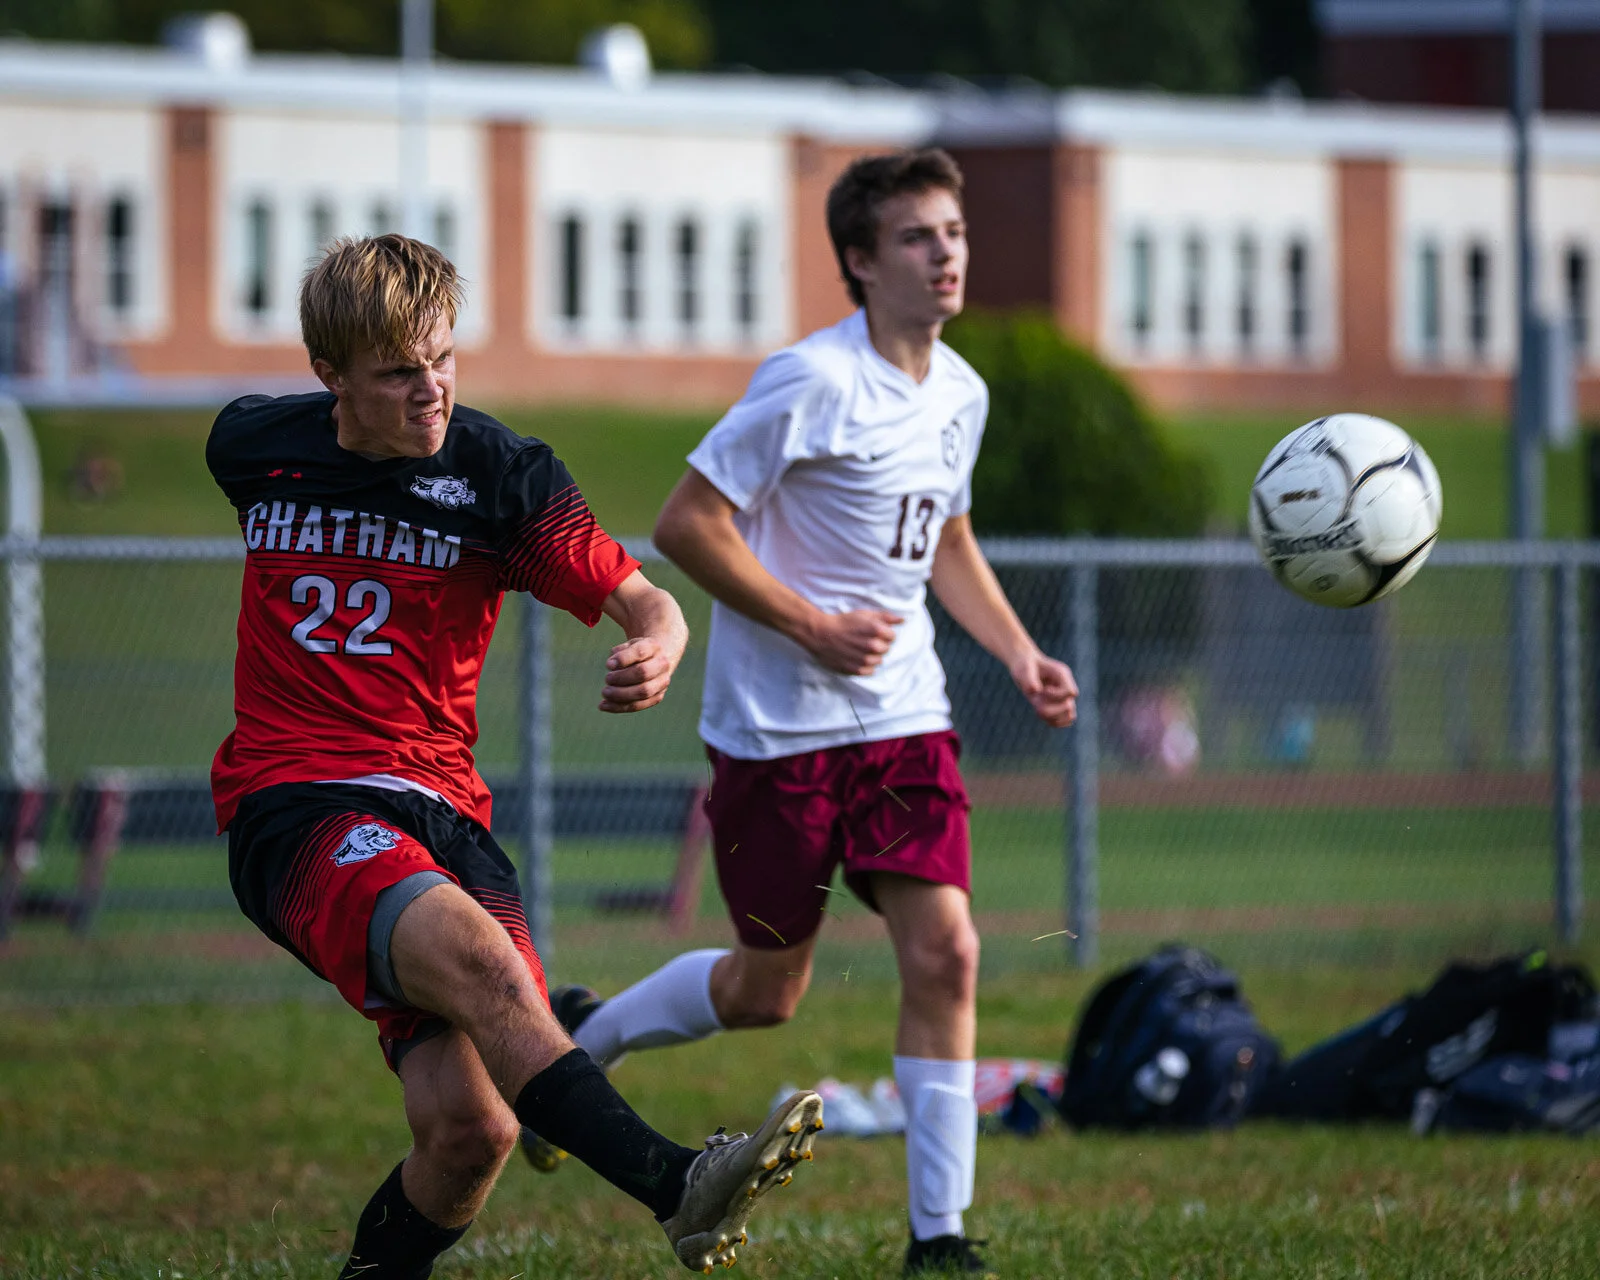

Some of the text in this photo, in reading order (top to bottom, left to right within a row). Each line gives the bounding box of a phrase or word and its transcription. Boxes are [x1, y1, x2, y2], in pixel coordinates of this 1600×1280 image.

[246, 501, 461, 568] CHATHAM
[888, 494, 935, 560] 13
[290, 575, 393, 655] 22
